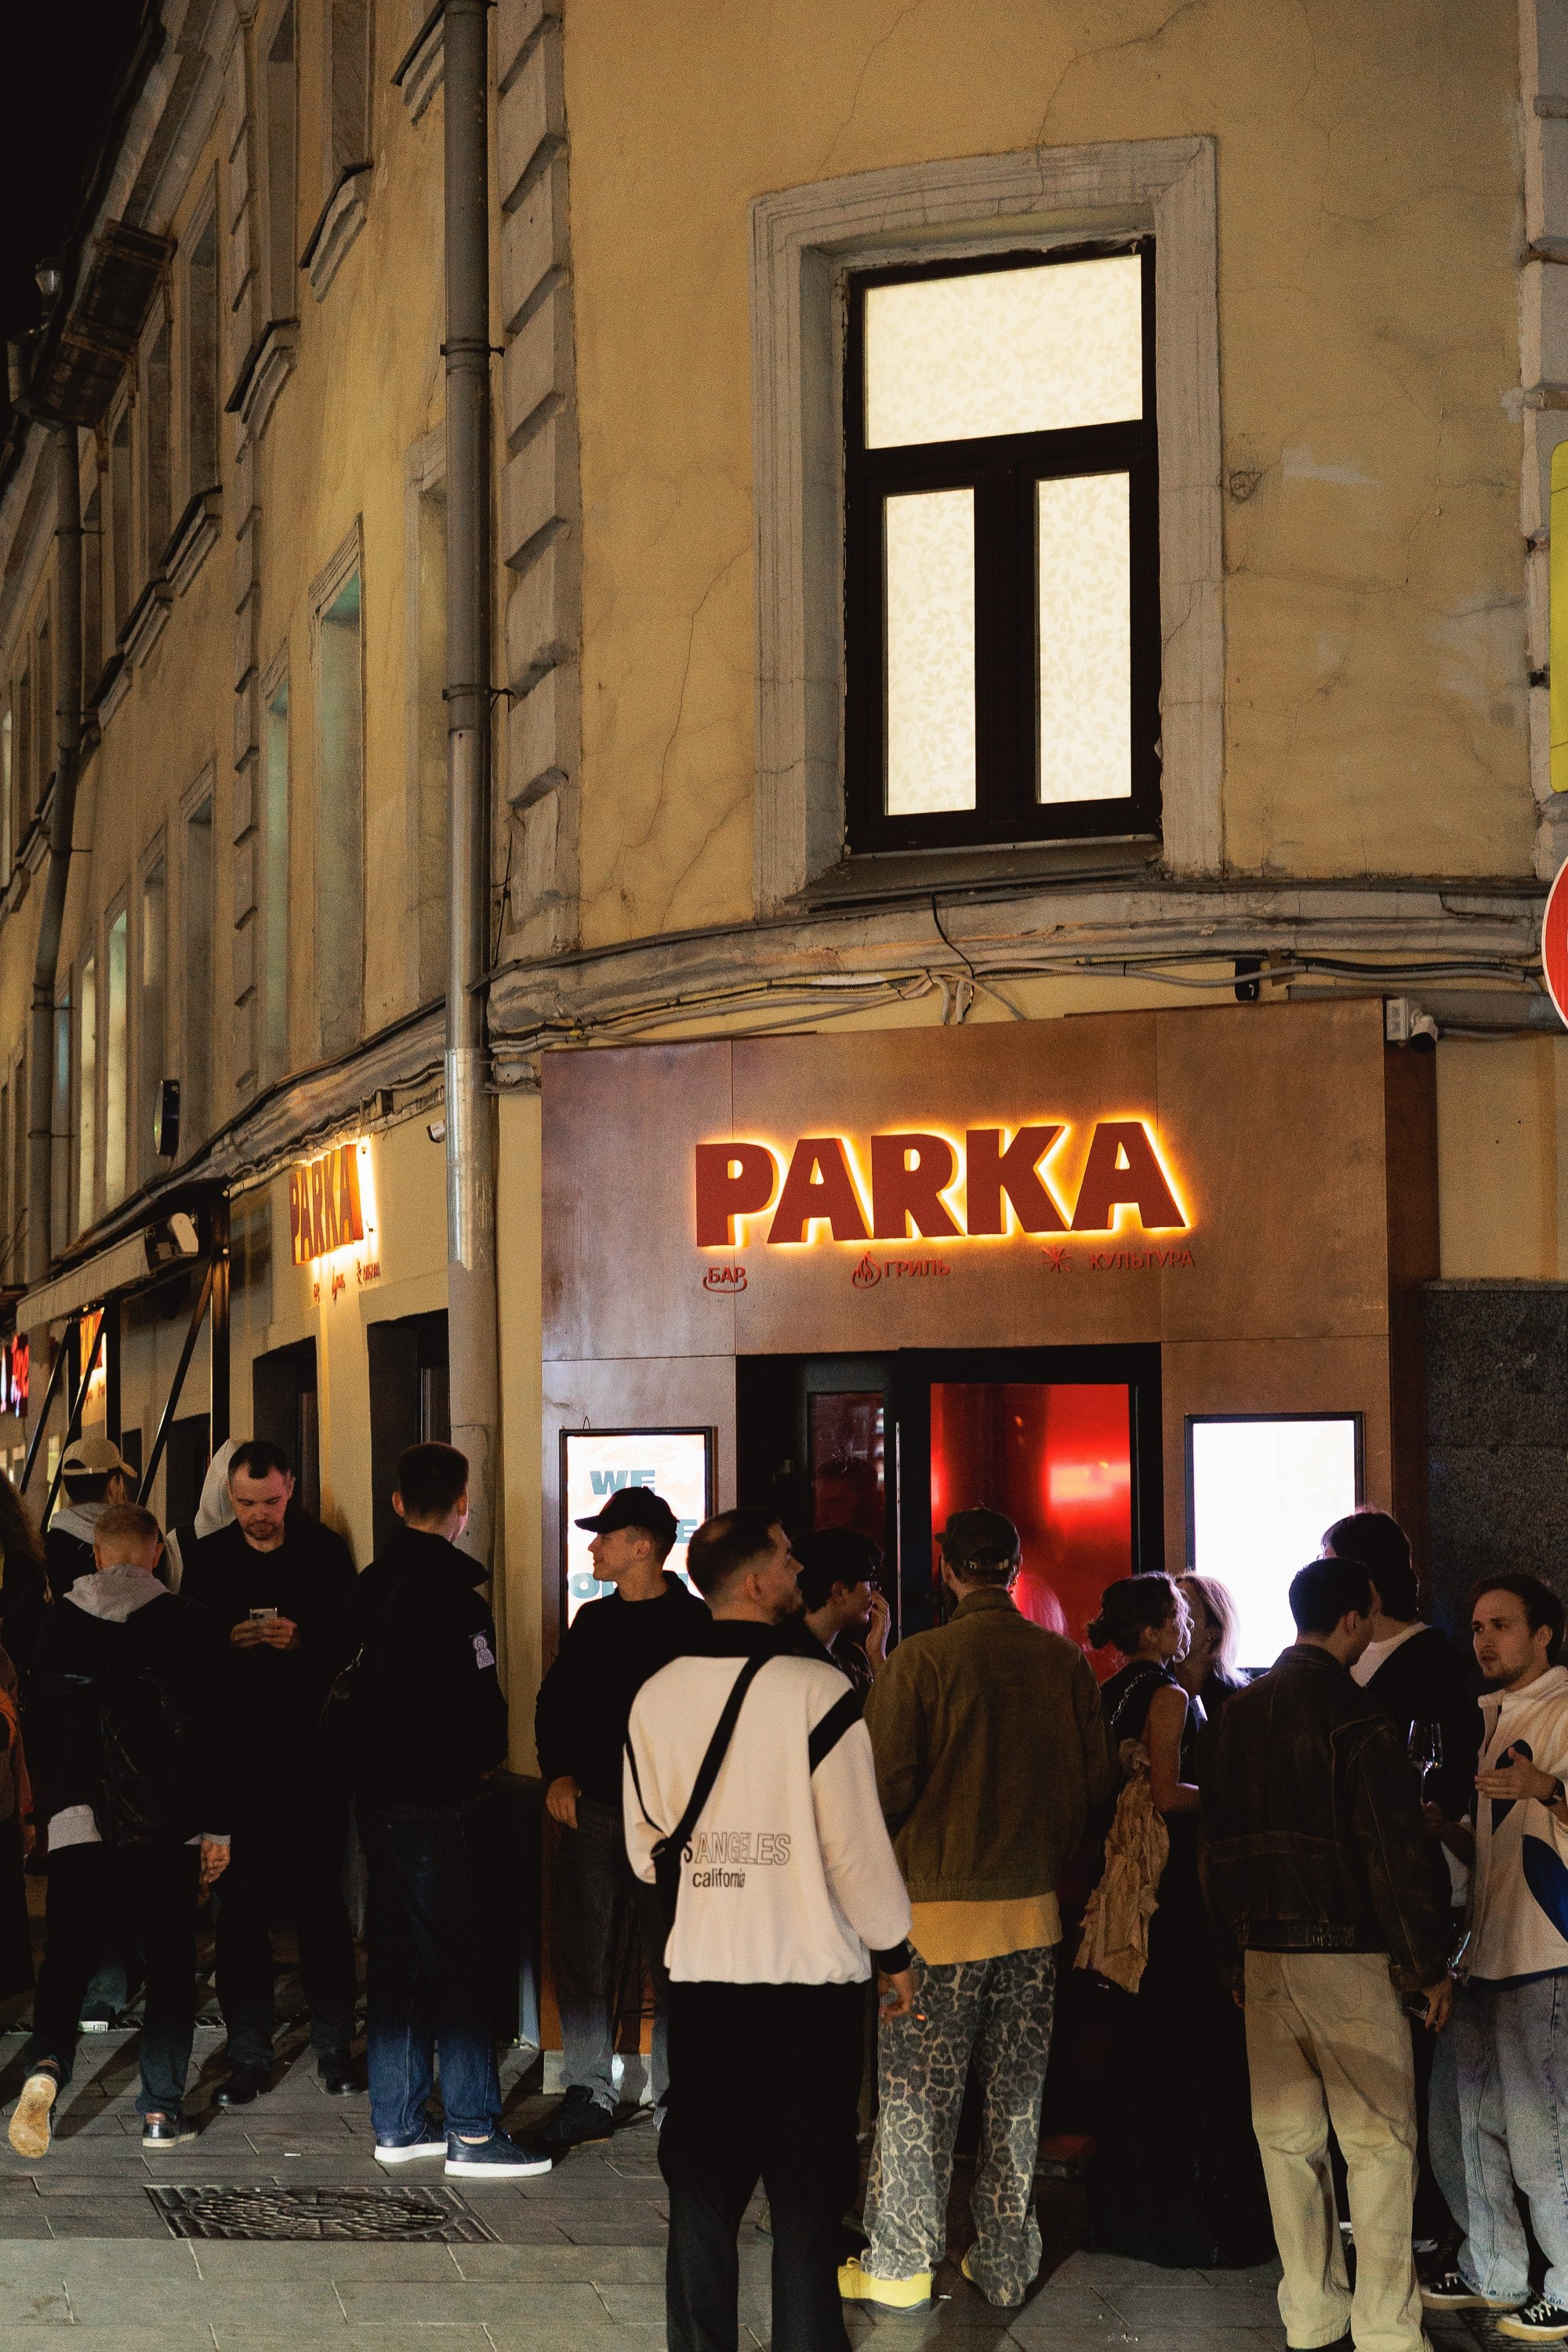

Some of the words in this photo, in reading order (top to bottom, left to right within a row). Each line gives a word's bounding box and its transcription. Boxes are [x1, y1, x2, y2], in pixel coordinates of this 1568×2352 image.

[695, 1121, 1189, 1247] PARKA
[289, 1144, 364, 1266] PARKA
[707, 1266, 746, 1283] БАР
[884, 1259, 951, 1278] ГРИЛЬ
[1089, 1250, 1196, 1271] КУЛЬТУРА
[695, 1831, 791, 1866] ANGELES
